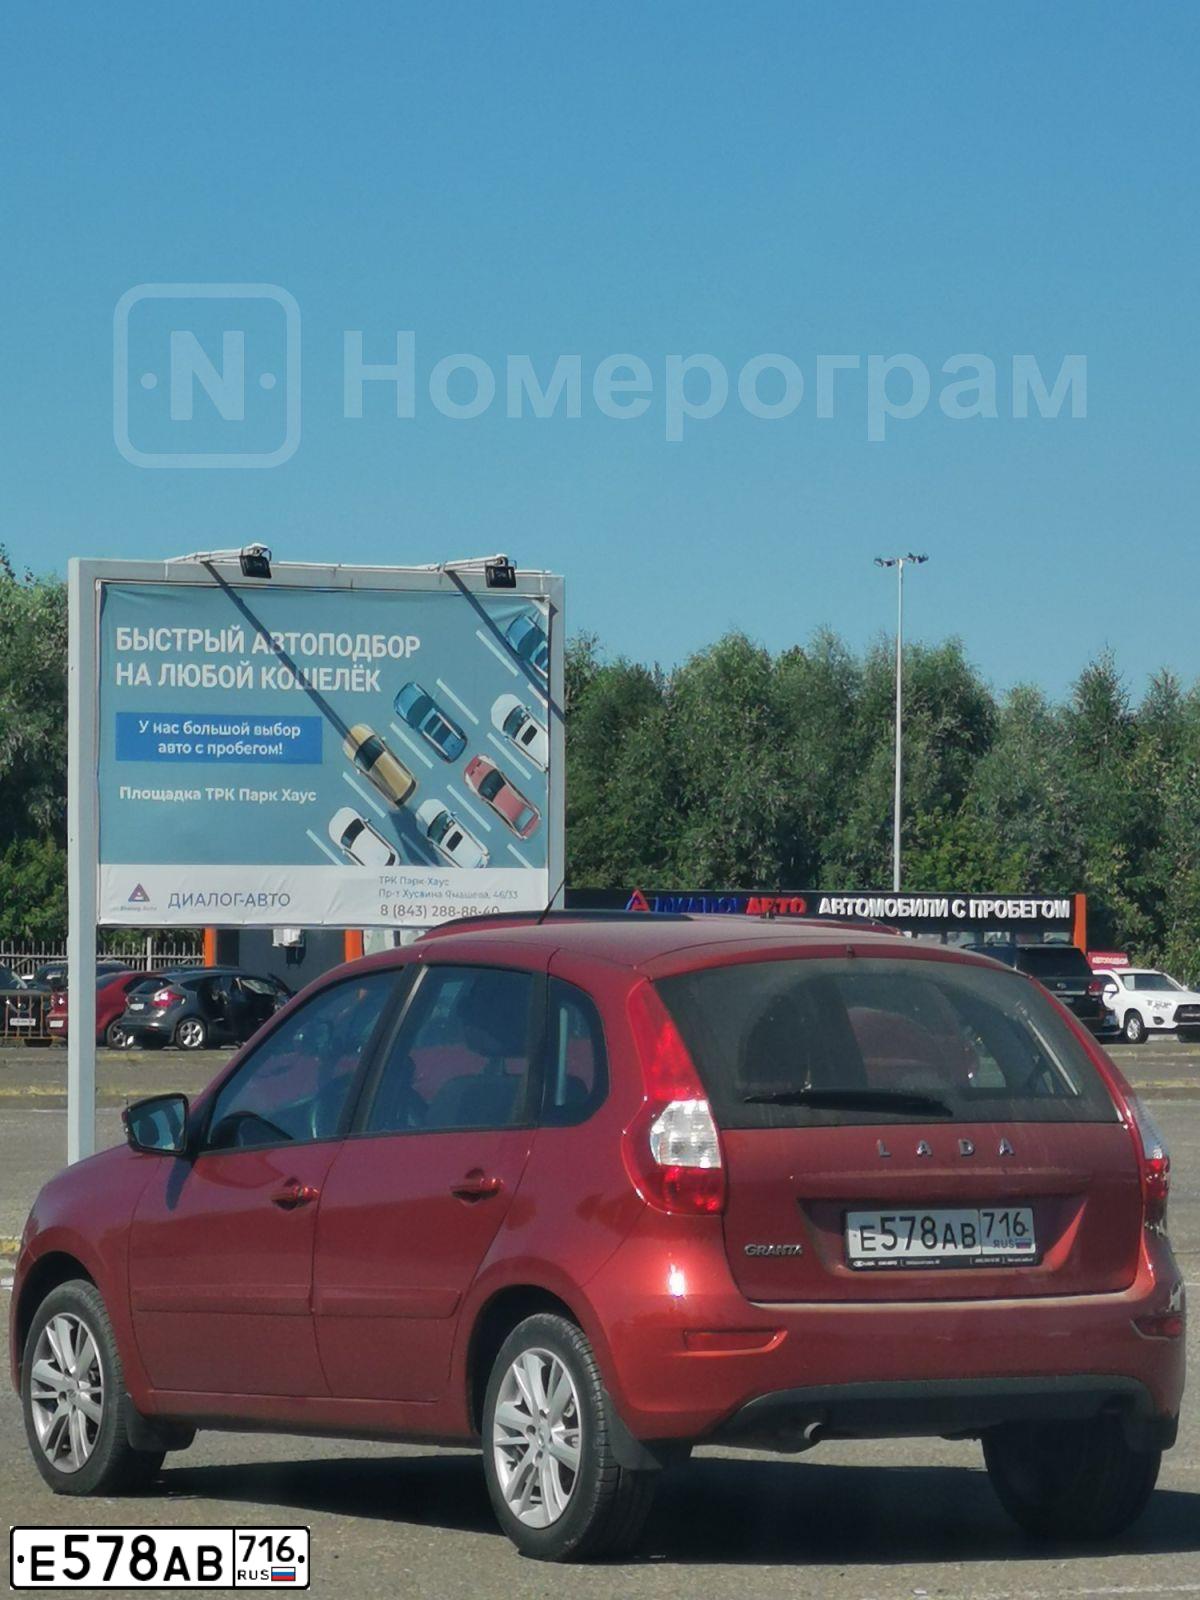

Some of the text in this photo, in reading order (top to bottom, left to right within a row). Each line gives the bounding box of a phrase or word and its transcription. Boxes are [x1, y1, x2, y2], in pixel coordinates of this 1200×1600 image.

[116, 625, 420, 660] БЫСТРЫЙ АВТОПОДБОР
[116, 660, 381, 692] НА ЛЮБОЙ КОШЕЛЁК
[139, 720, 301, 738] У нас большой выбор
[158, 741, 283, 757] авто с пробегом!
[119, 786, 317, 805] Площадка ТРК Парк Хаус
[379, 875, 450, 888] ТРК Парк Хаус
[168, 892, 291, 910] ДИАЛОГ-АВТО
[818, 897, 1071, 919] АВТОМОБИЛИ С ПРОБЕГОМ
[380, 904, 389, 916] 8
[393, 904, 428, 919] (843)
[877, 1138, 1015, 1157] LADA
[858, 1211, 1027, 1252] Е578АВ 716
[744, 1243, 803, 1256] GRANTA
